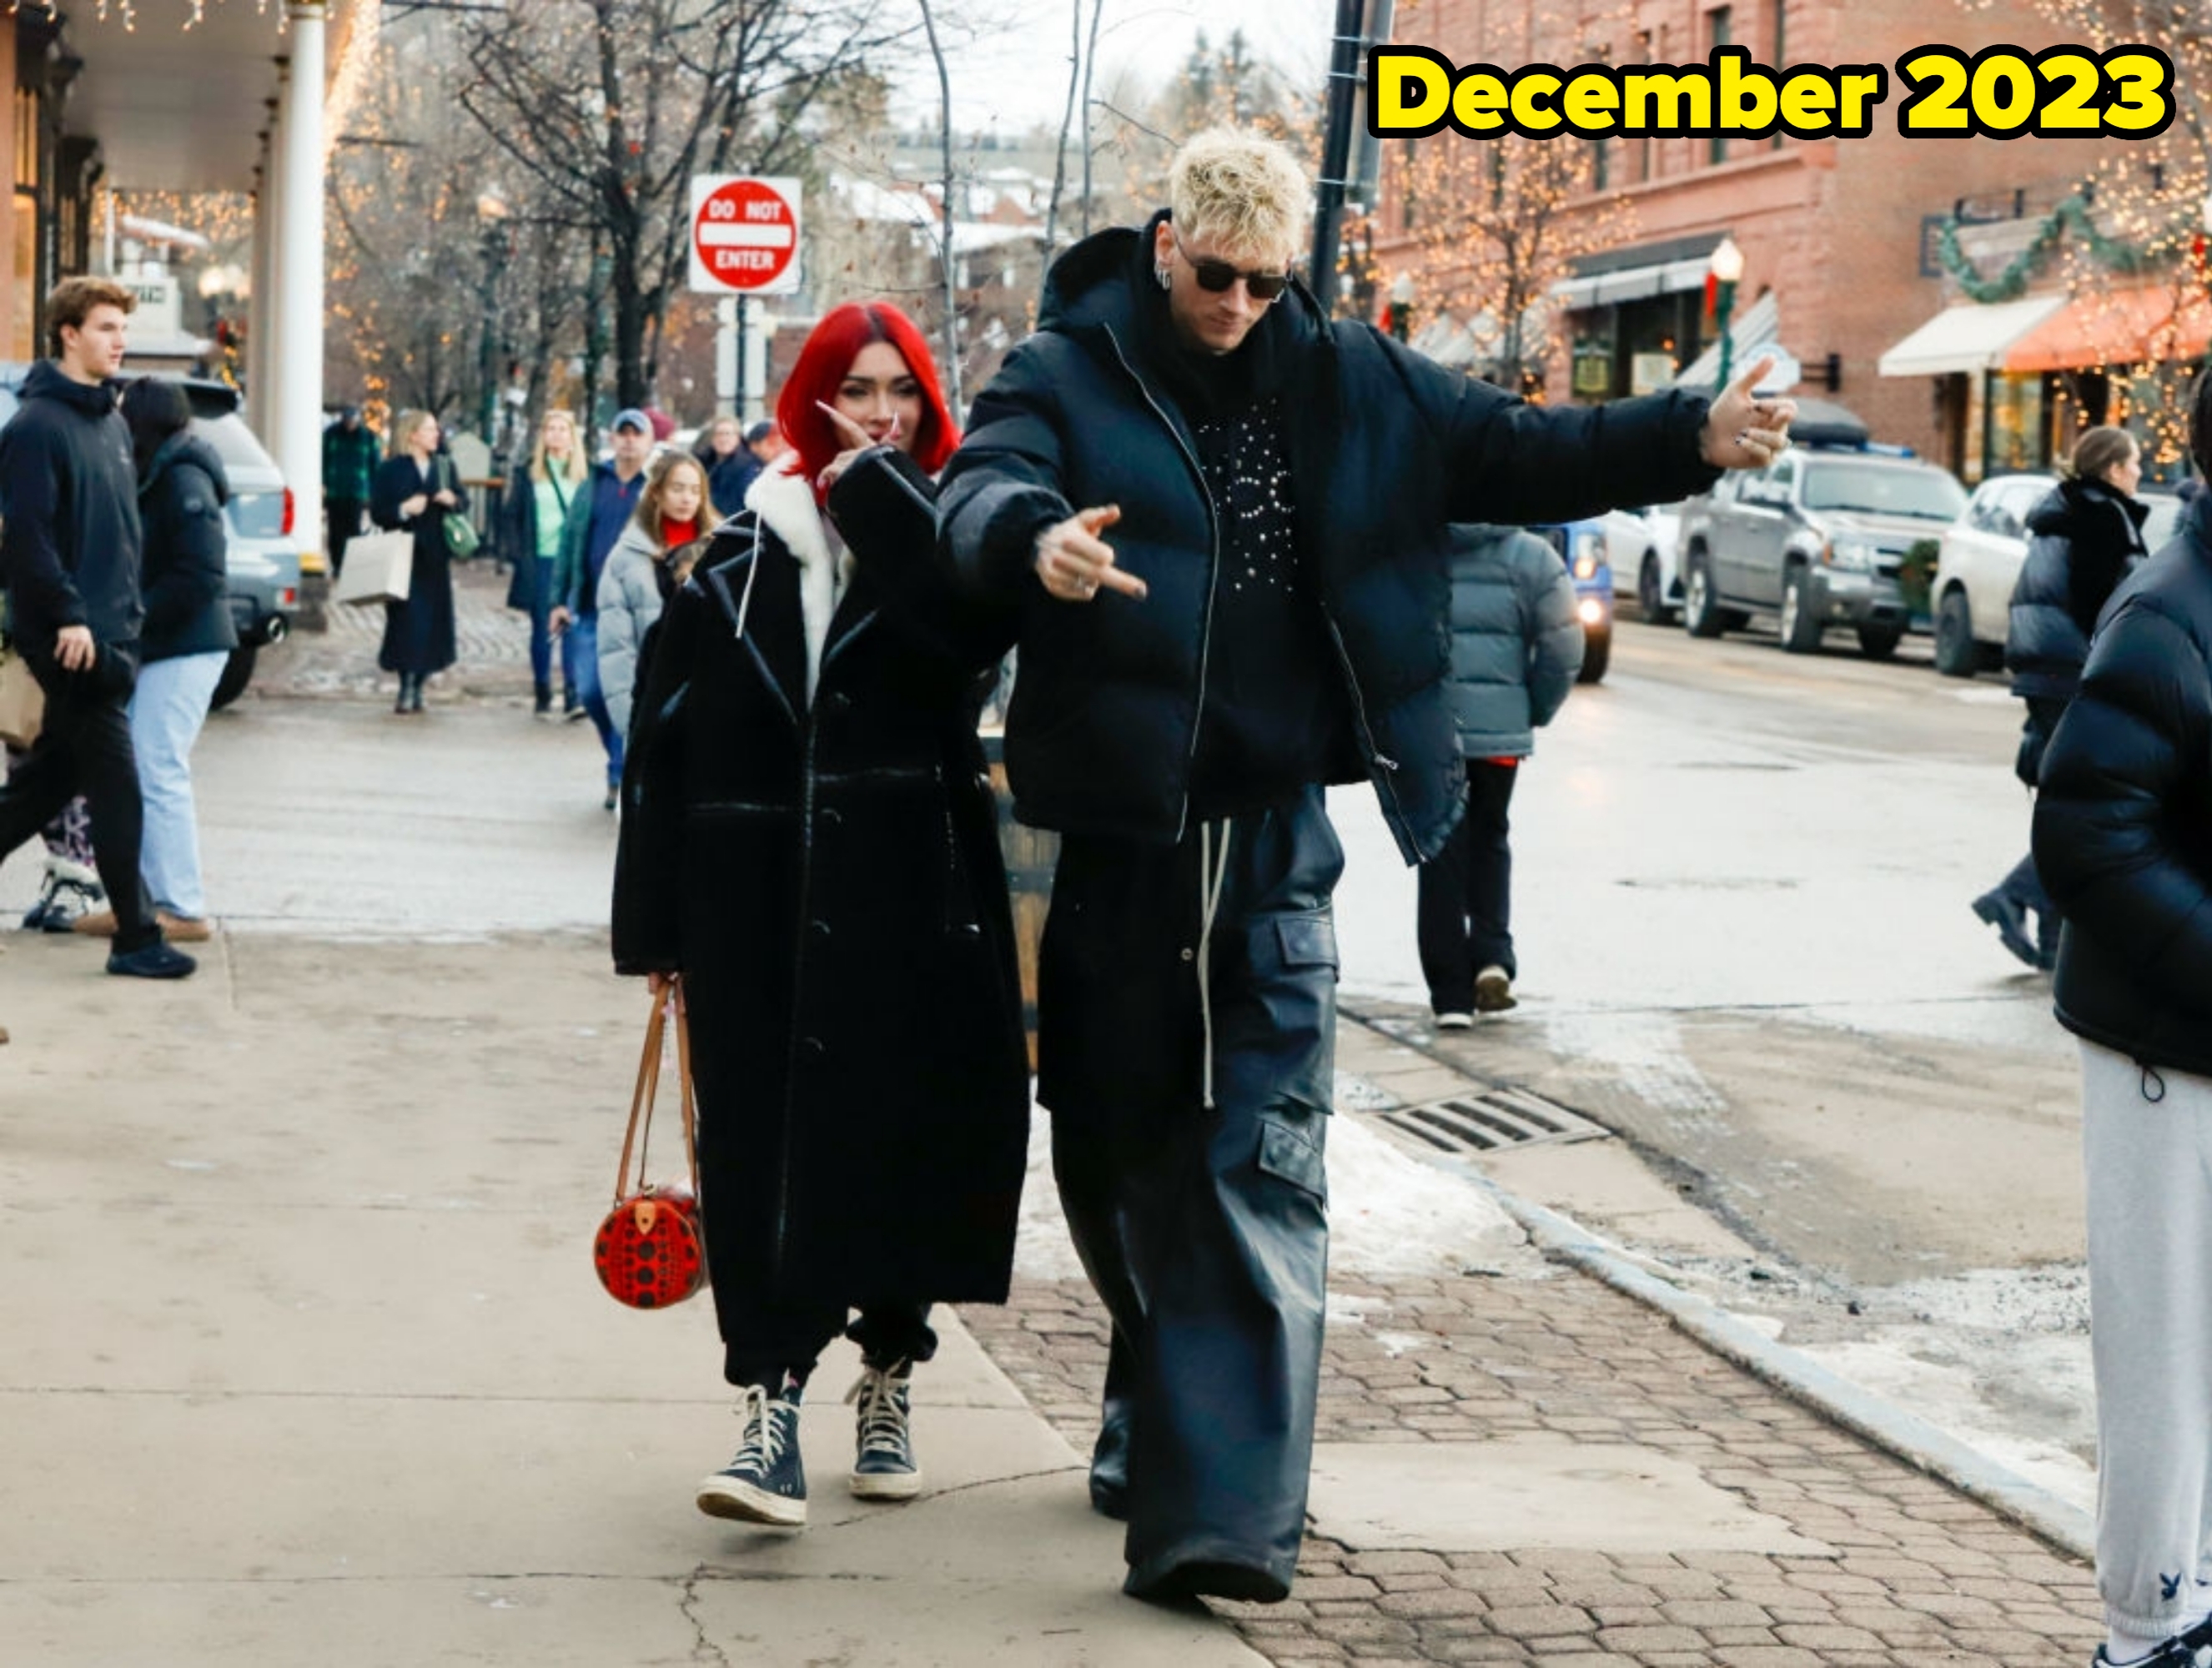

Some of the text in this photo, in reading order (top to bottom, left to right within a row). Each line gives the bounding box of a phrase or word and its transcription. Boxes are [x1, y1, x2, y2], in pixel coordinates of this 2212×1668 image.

[708, 199, 782, 220] DO NOT
[715, 249, 775, 269] ENTER
